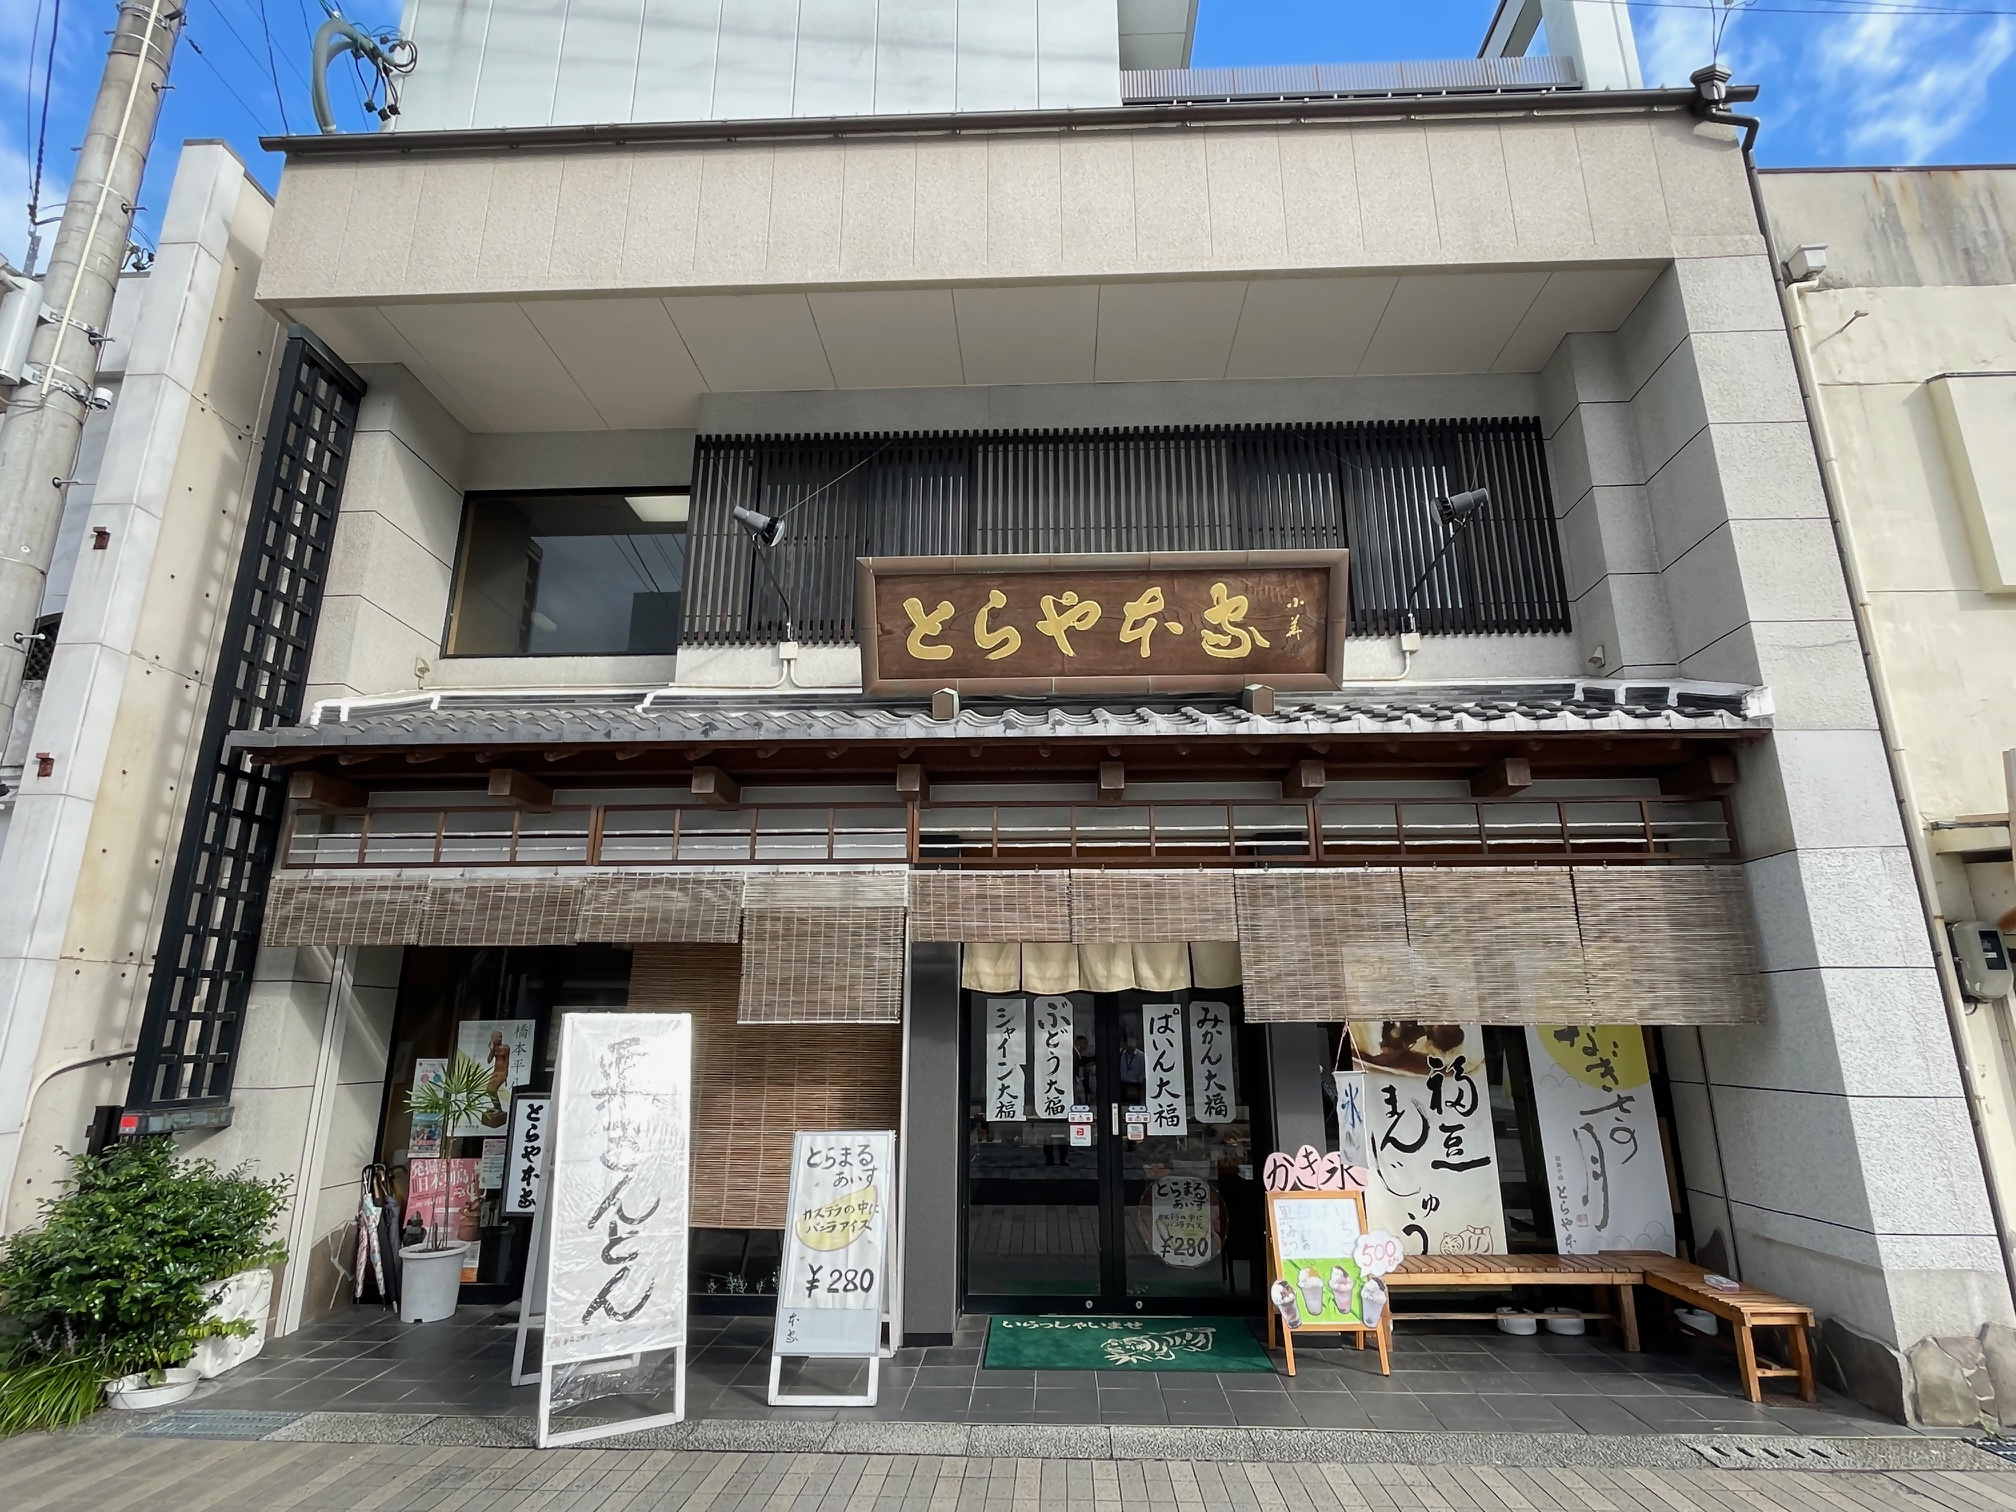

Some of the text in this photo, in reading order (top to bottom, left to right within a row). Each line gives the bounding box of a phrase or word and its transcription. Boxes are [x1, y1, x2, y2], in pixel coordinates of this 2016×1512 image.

[995, 1007, 1018, 1119] シャイン大福
[1038, 1001, 1071, 1116] ぶどう大福
[1149, 1008, 1181, 1128] ぱいん大福
[1197, 1007, 1228, 1118] みかん大福
[1341, 1082, 1364, 1129] 氷
[1426, 1055, 1491, 1172] 福豆
[806, 1144, 874, 1170] とらまる
[1267, 1147, 1366, 1191] かき氷
[1370, 1084, 1441, 1255] まんじゅう
[833, 1166, 878, 1190] あいす
[1157, 1181, 1207, 1200] とらまる
[802, 1202, 880, 1221] カステラの中に
[1173, 1200, 1207, 1211] あいす
[1556, 1186, 1577, 1254] とらや本
[805, 1219, 872, 1233] バニラアイス
[1160, 1235, 1209, 1258] ¥280
[805, 1263, 875, 1298] ¥280
[1002, 1320, 1144, 1330] いらっしゃいませ
